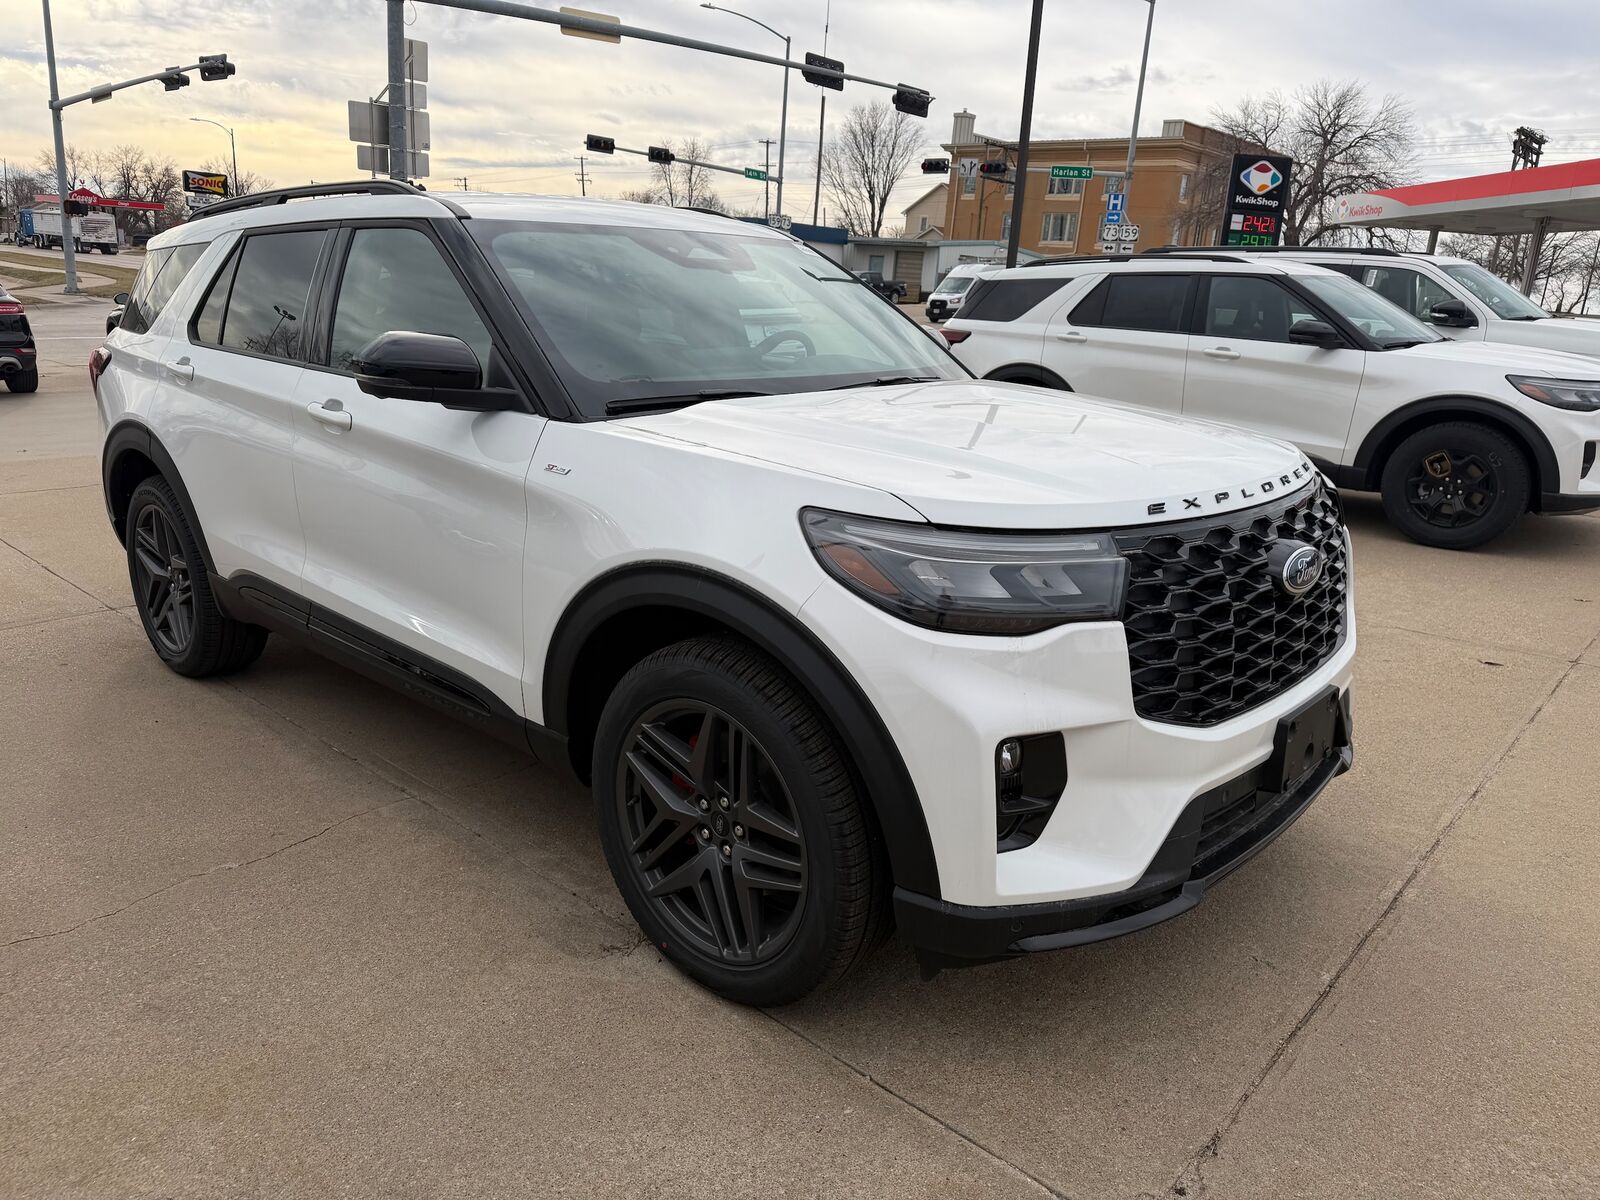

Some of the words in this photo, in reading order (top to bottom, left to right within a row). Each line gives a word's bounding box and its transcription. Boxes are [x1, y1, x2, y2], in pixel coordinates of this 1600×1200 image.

[760, 172, 766, 180] St
[1053, 168, 1079, 177] Harlan
[1081, 169, 1091, 177] St
[191, 177, 223, 189] SONIC
[1108, 194, 1123, 211] H
[1235, 194, 1279, 208] KwikShop
[1349, 205, 1383, 216] KwikShop
[1105, 227, 1118, 238] 73
[1120, 228, 1138, 238] 159
[1147, 461, 1311, 516] EXPLORER
[1296, 552, 1319, 584] Ford
